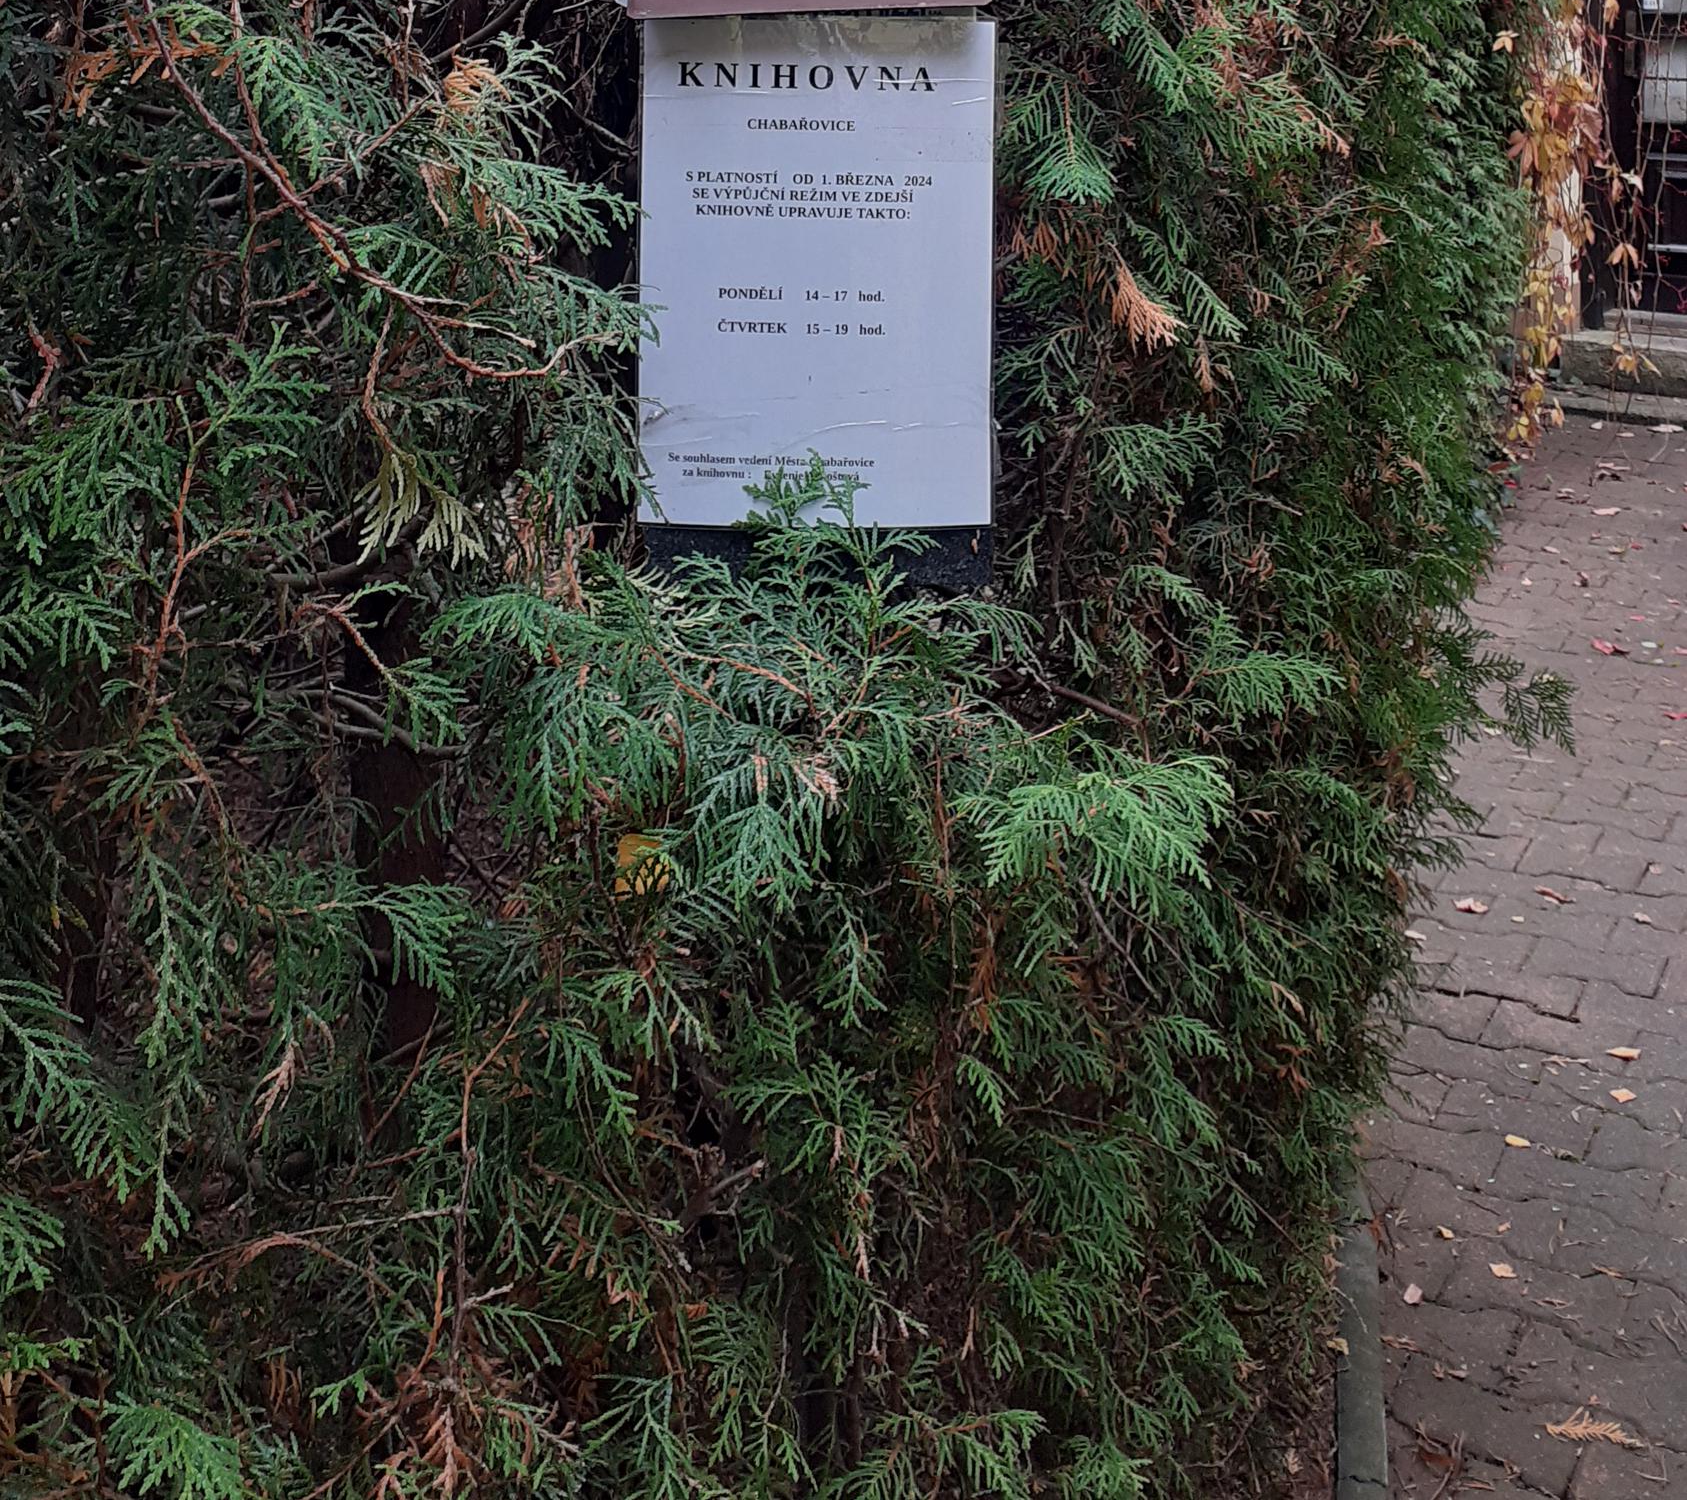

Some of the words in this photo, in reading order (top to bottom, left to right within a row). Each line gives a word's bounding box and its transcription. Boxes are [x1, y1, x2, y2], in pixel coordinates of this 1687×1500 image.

[677, 60, 938, 92] KNIHOVNA
[747, 116, 856, 132] CHABAŘOVICE
[685, 170, 694, 182] S
[697, 170, 779, 185] PLATNOSTÍ
[792, 173, 814, 185] OD
[822, 174, 832, 186] 1.
[835, 171, 895, 187] BŘEZNA
[904, 175, 933, 187] 2024
[692, 187, 710, 200] SE
[789, 187, 837, 202] REŽIM
[841, 190, 861, 203] VE
[864, 188, 914, 203] ZDEJŠÍ
[695, 203, 775, 218] KNIHOVNĚ
[778, 206, 853, 219] UPRAVUJE
[855, 207, 911, 220] TAKTO:
[718, 285, 783, 301] PONDĚLÍ
[805, 289, 819, 301] 14
[834, 290, 848, 302] 17
[858, 290, 885, 303] hod.
[717, 318, 788, 334] ČTVRTEK
[806, 323, 820, 335] 15
[835, 323, 849, 336] 19
[859, 323, 886, 336] hod.
[667, 451, 681, 462] Se
[682, 453, 736, 465] souhlasem
[738, 454, 773, 466] vedení
[809, 456, 875, 468] Cabařovice
[696, 468, 745, 479] knihovnu
